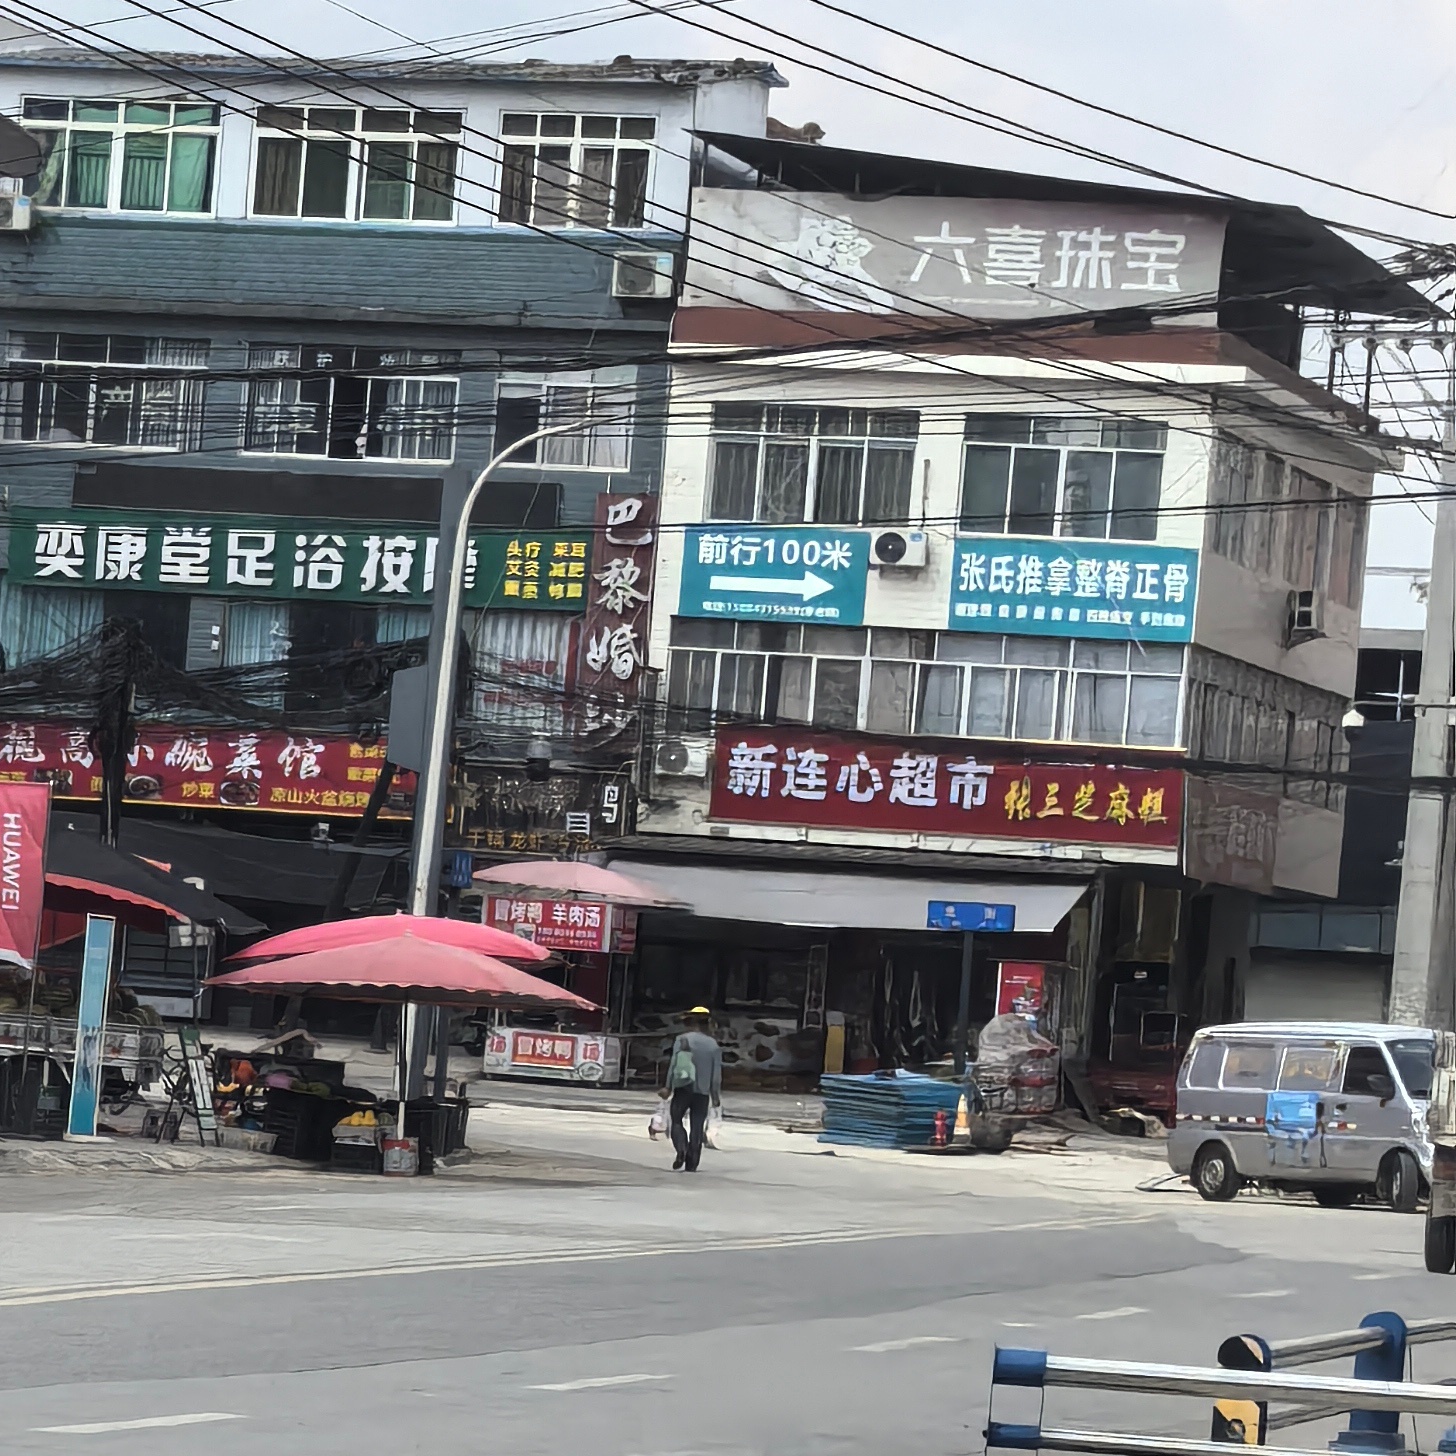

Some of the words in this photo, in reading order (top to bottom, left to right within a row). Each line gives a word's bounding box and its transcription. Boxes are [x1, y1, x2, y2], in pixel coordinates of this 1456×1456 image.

[909, 219, 1187, 293] 六喜珠宝
[697, 533, 853, 571] 前行100米
[959, 552, 1190, 604] 张氏推拿整脊正骨
[726, 741, 996, 811] 新连心超市
[1, 812, 23, 911] HUAWEI
